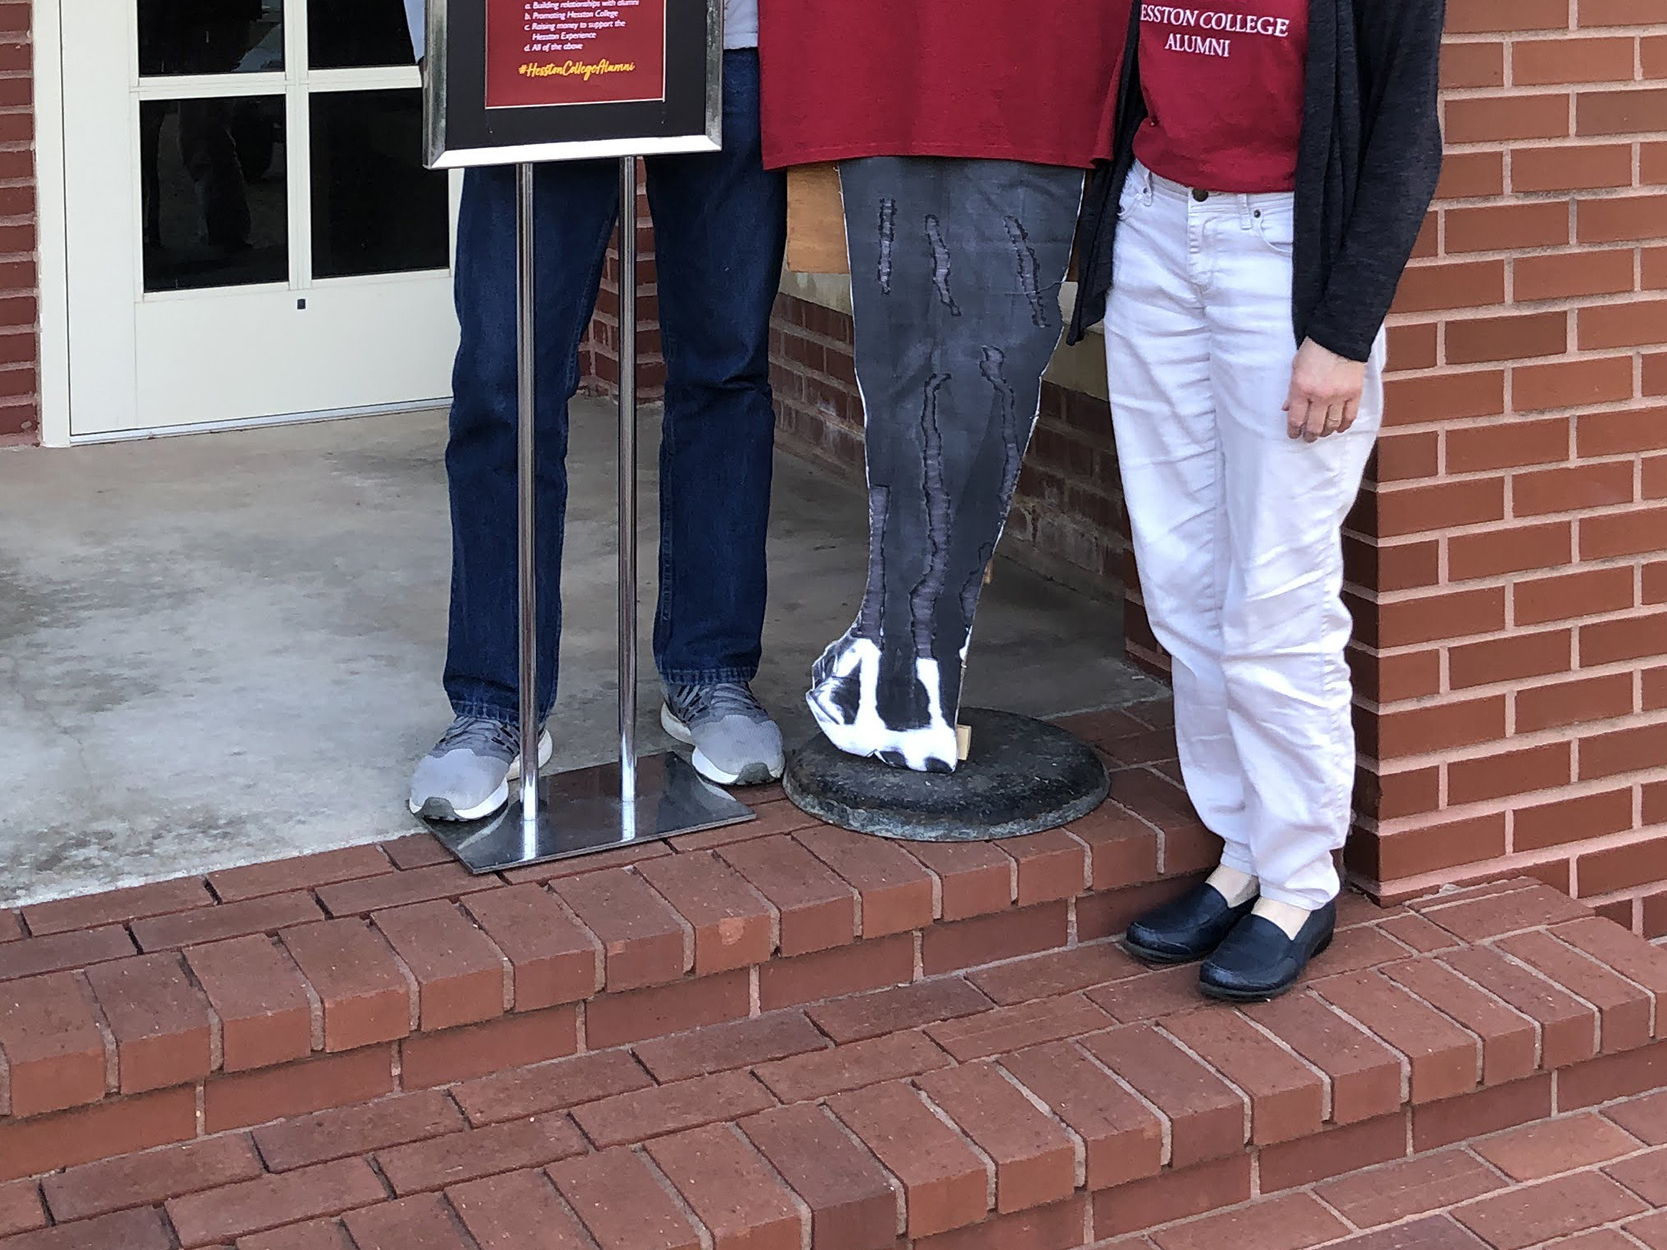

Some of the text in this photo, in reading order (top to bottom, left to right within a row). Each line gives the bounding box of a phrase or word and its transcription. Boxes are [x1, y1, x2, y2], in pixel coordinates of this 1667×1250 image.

[533, 1, 560, 10] Building
[560, 0, 601, 9] relationships
[602, 0, 616, 7] with
[532, 12, 566, 21] Promoting
[567, 10, 594, 19] Hesston
[595, 9, 619, 19] College
[1140, 4, 1290, 37] ESSTON COLLEGE
[532, 23, 556, 32] Raising
[557, 22, 578, 31] money
[588, 20, 613, 30] support
[615, 19, 626, 28] the
[532, 31, 597, 41] Hesston Experience
[532, 43, 541, 51] All
[542, 43, 550, 52] of
[551, 43, 562, 51] the
[564, 42, 583, 50] above
[1164, 32, 1231, 57] ALUMNI
[518, 58, 635, 82] #HesstonCollegeAlumni
